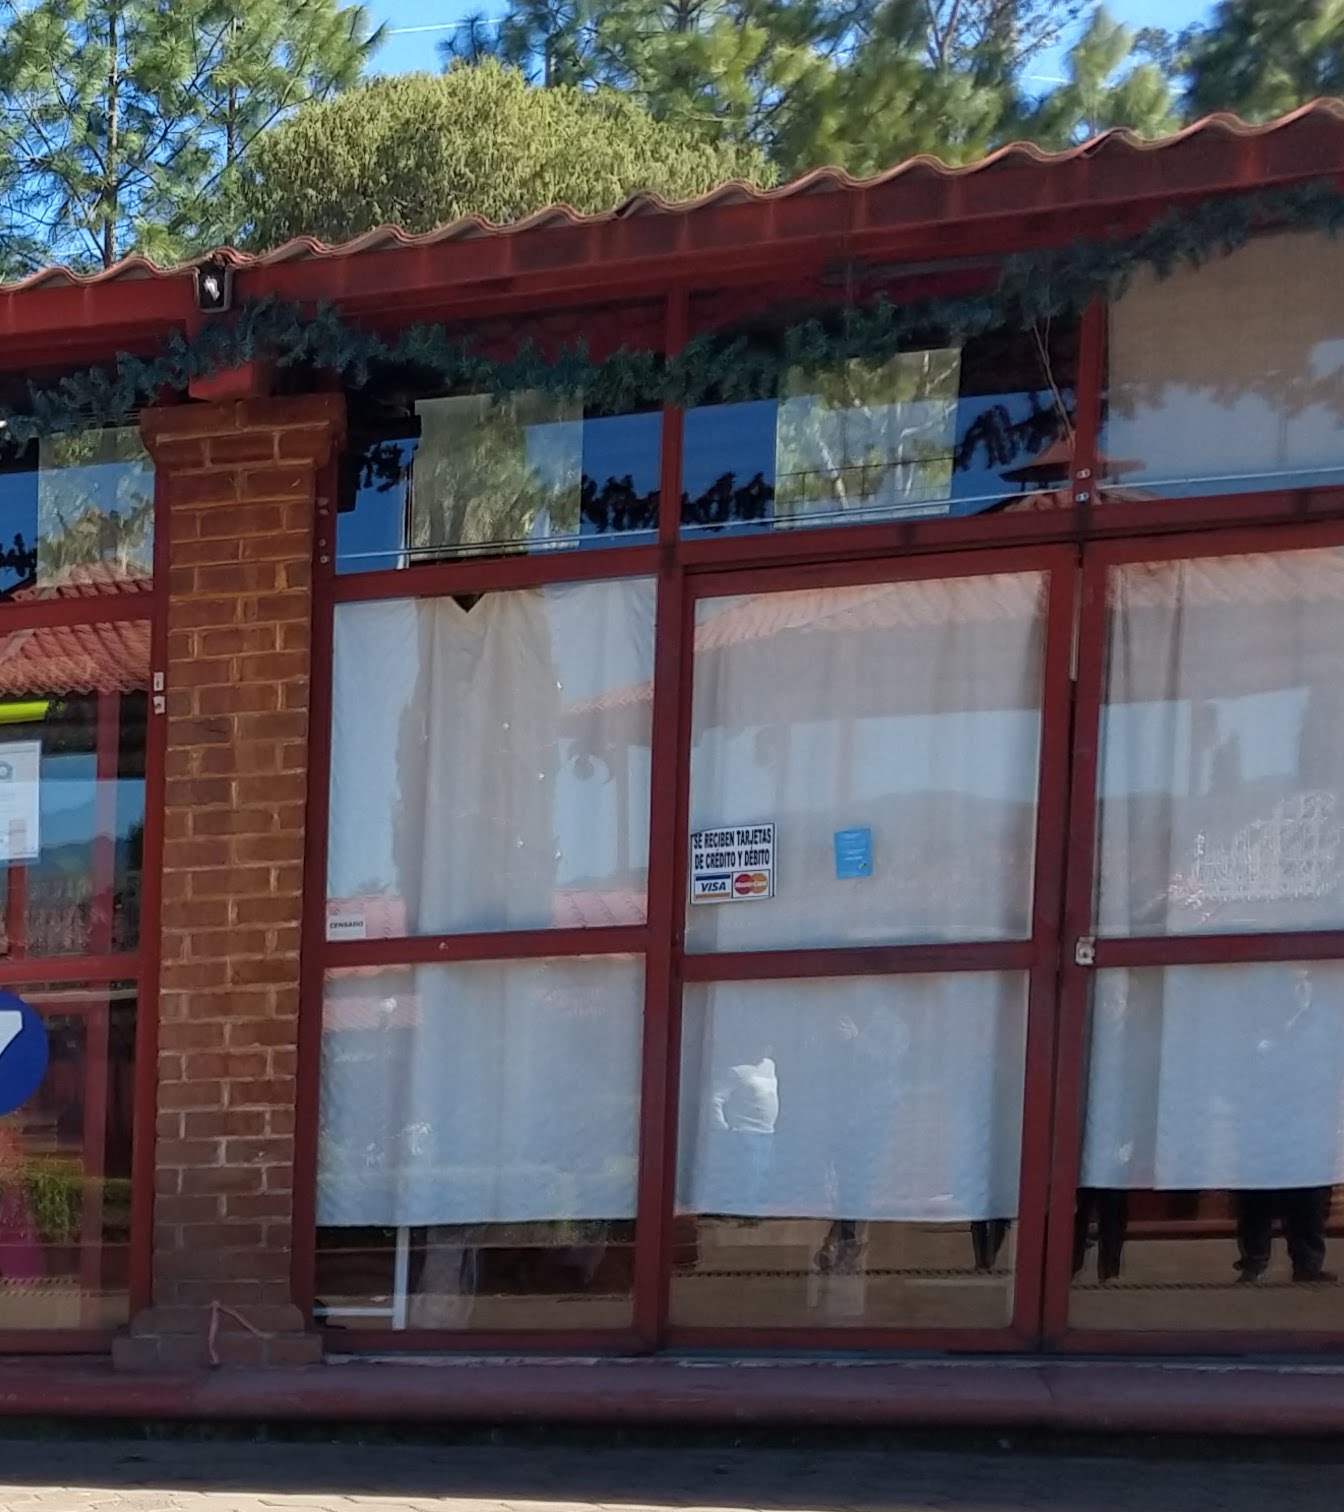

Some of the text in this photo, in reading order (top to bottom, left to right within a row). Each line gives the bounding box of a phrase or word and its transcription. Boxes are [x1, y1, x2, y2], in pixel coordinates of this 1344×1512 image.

[693, 828, 771, 849] SE RECIBEN TARJETAS
[695, 853, 704, 870] DE
[737, 850, 743, 867] Y
[744, 846, 770, 866] DÉBITO
[701, 881, 727, 892] VISA
